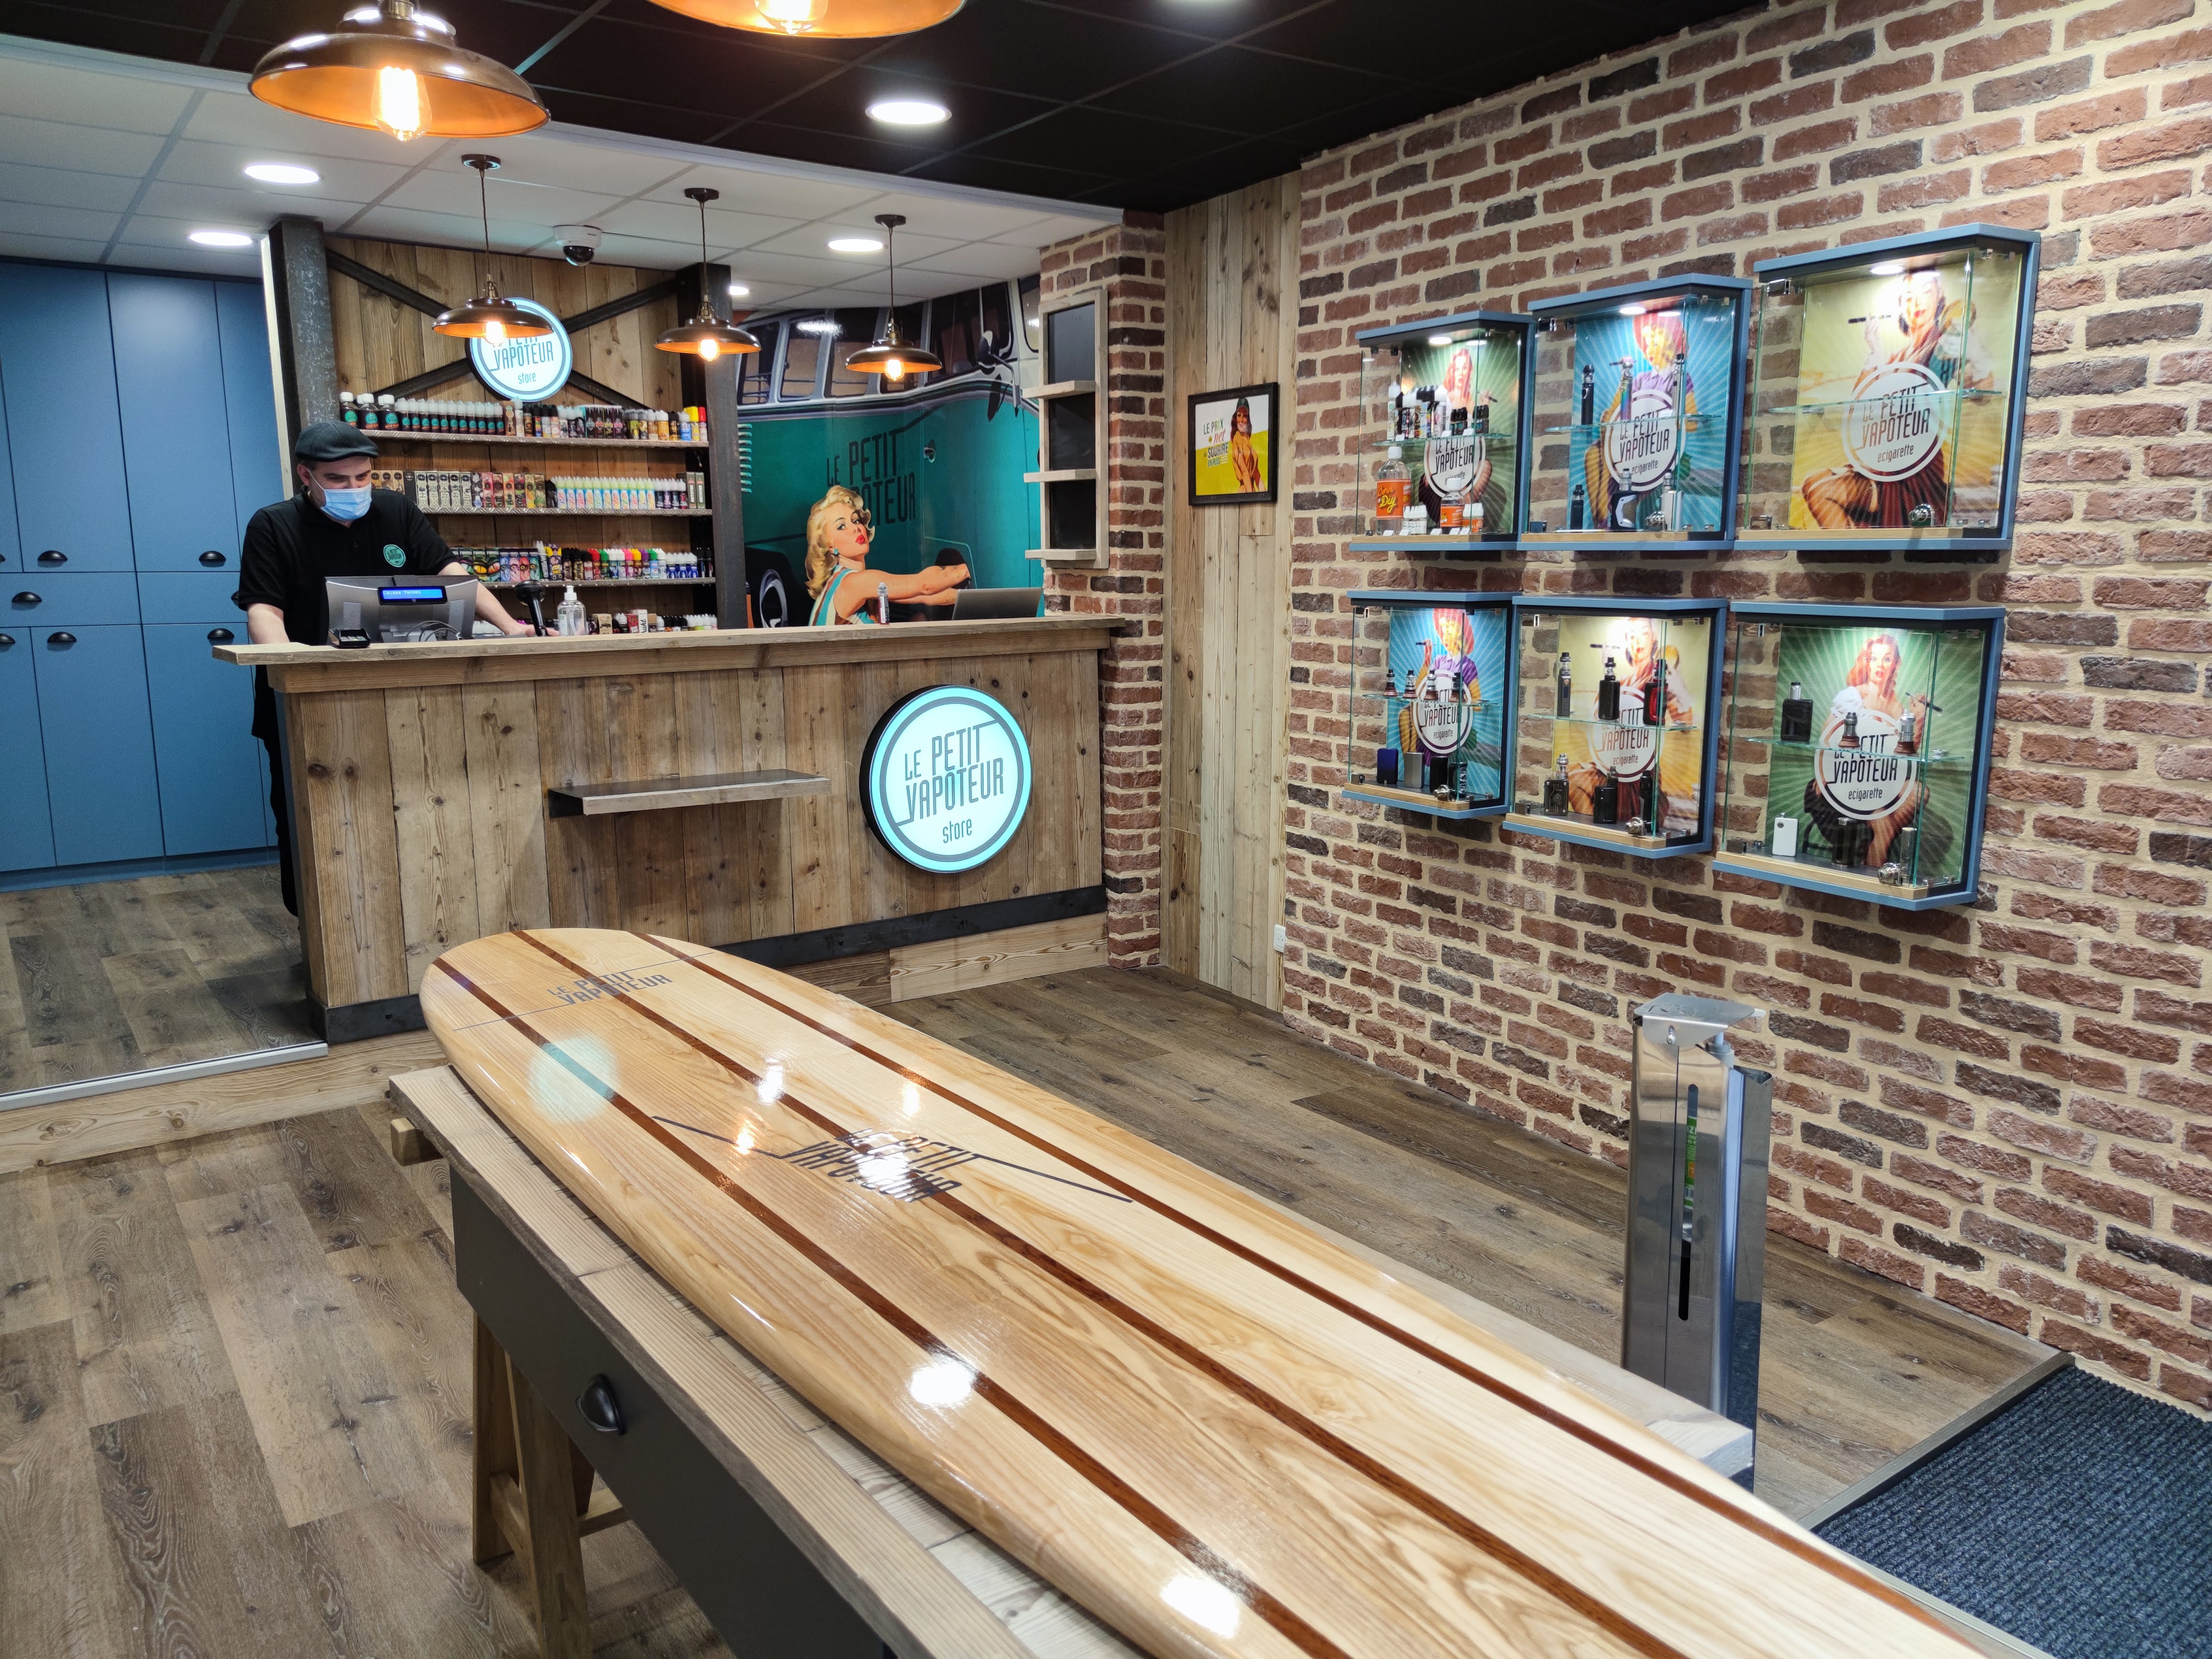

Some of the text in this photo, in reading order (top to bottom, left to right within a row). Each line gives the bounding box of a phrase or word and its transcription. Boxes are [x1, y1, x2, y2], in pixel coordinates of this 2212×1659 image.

[494, 341, 554, 370] VAPOTEUR
[518, 373, 536, 384] store
[1204, 418, 1224, 435] LE PRIX
[1213, 428, 1226, 444] net
[1862, 408, 1931, 448] VAPOTEUR
[1208, 443, 1229, 458] SOURIRE
[1620, 429, 1670, 463] VAPOTEUR
[1877, 443, 1915, 463] ecigarette
[827, 430, 898, 488] LE PETIT
[1436, 444, 1474, 474] VAPOTEUR
[1631, 459, 1658, 476] ecigarette
[850, 472, 916, 526] OTEUR
[1433, 728, 1454, 740] ecigarette
[1602, 728, 1649, 751] VAPOTEUR
[904, 725, 981, 781] LE PETIT
[1612, 754, 1639, 766] ecigarette
[1834, 757, 1898, 784] VAPOTEUR
[906, 757, 1004, 821] VAPOTEUR
[1847, 787, 1883, 802] ecigarette
[942, 818, 972, 843] store
[546, 972, 635, 996] LE PETIT
[557, 974, 673, 1004] VAPOTEUR
